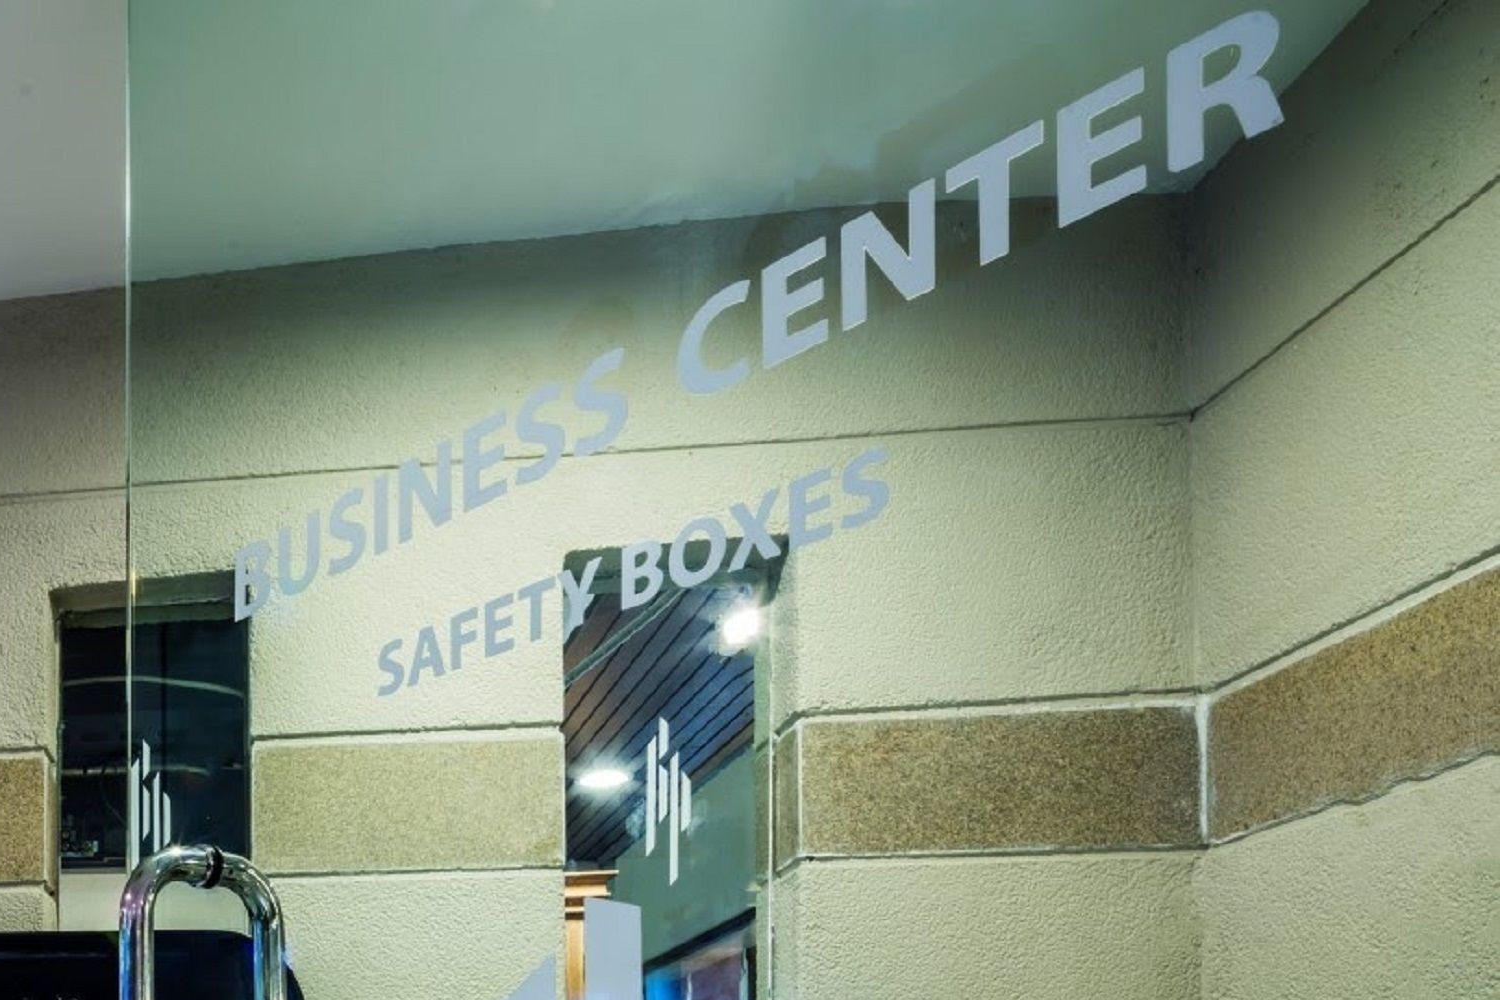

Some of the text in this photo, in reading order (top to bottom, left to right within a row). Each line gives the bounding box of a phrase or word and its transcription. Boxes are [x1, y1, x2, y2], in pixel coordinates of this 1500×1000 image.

[233, 10, 1284, 620] BUSINESS CENTER
[375, 448, 890, 696] SAFETY BOXES
